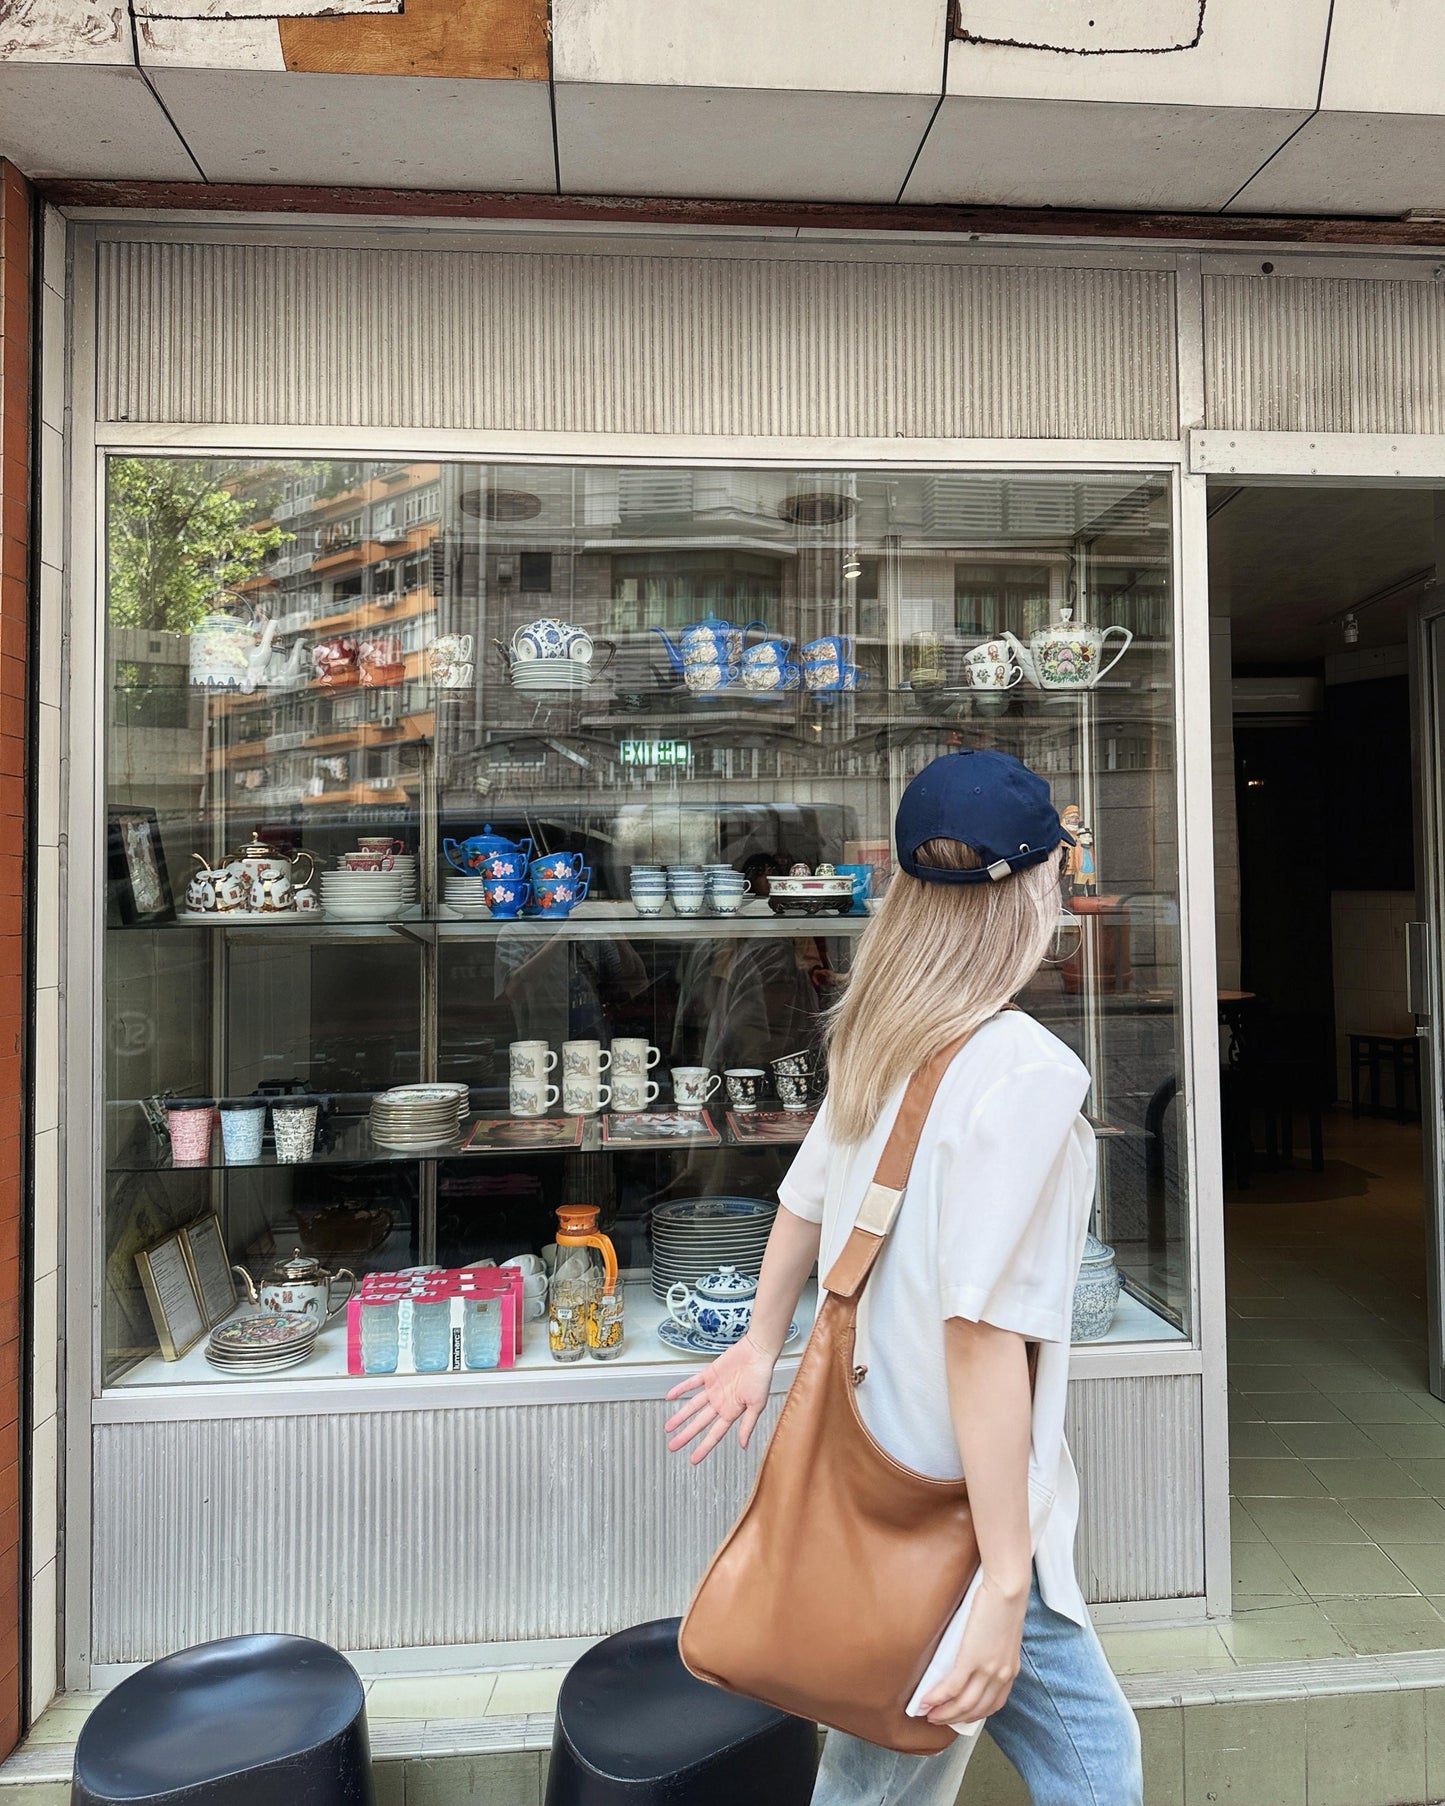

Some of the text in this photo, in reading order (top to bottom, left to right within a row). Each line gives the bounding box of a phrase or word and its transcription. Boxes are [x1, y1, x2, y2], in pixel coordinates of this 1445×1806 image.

[622, 741, 653, 765] EXIT
[657, 741, 689, 765] 出口
[366, 1270, 447, 1279] Lagon
[365, 1279, 448, 1289] Lagon
[352, 1291, 437, 1300] Lagon
